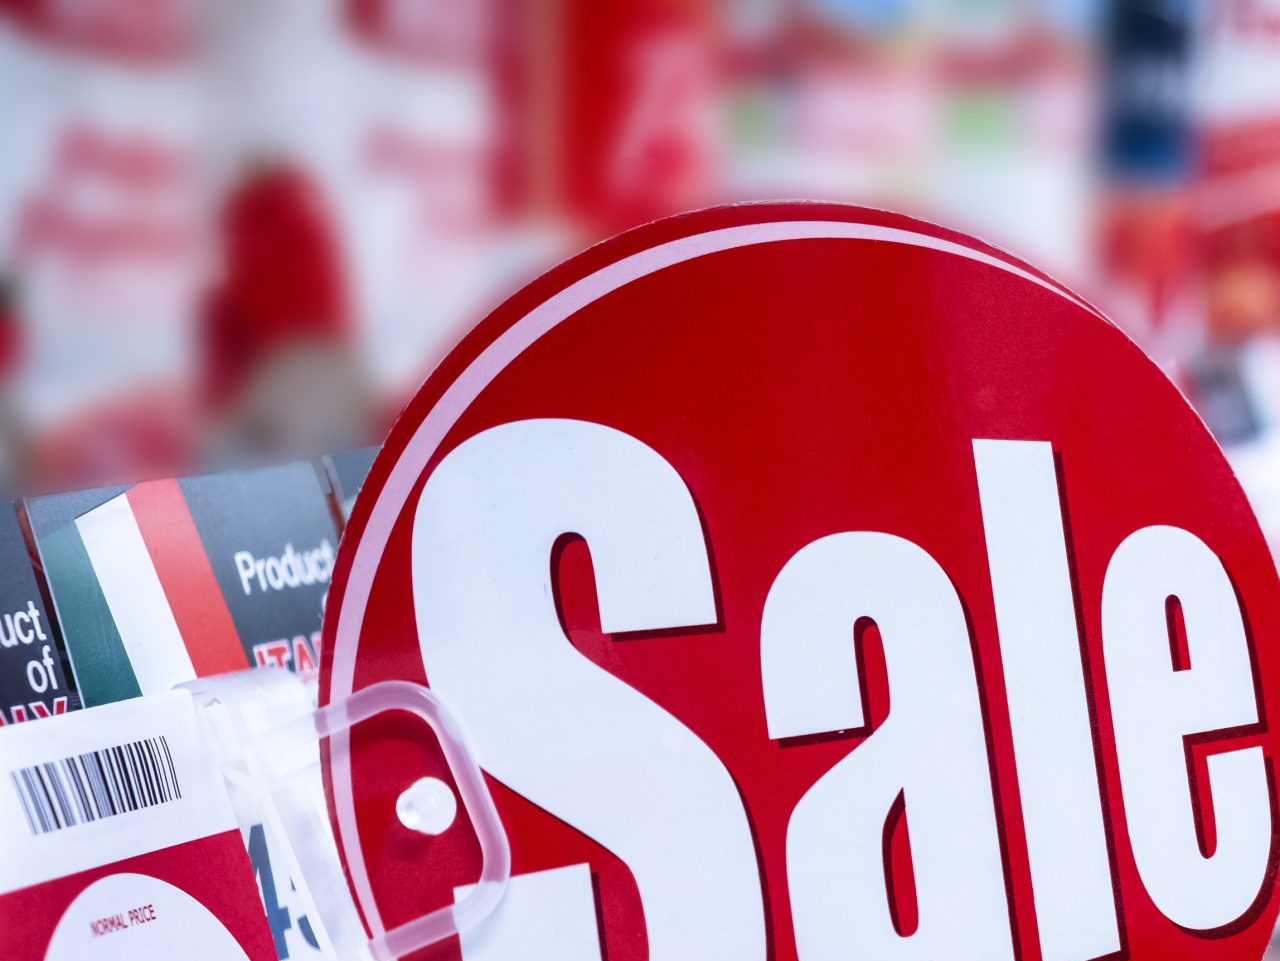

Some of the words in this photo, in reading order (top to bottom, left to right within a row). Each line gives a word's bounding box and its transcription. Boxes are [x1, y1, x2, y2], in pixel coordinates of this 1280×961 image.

[26, 645, 58, 693] of
[89, 914, 128, 938] NORMAL
[128, 904, 156, 926] PRICE
